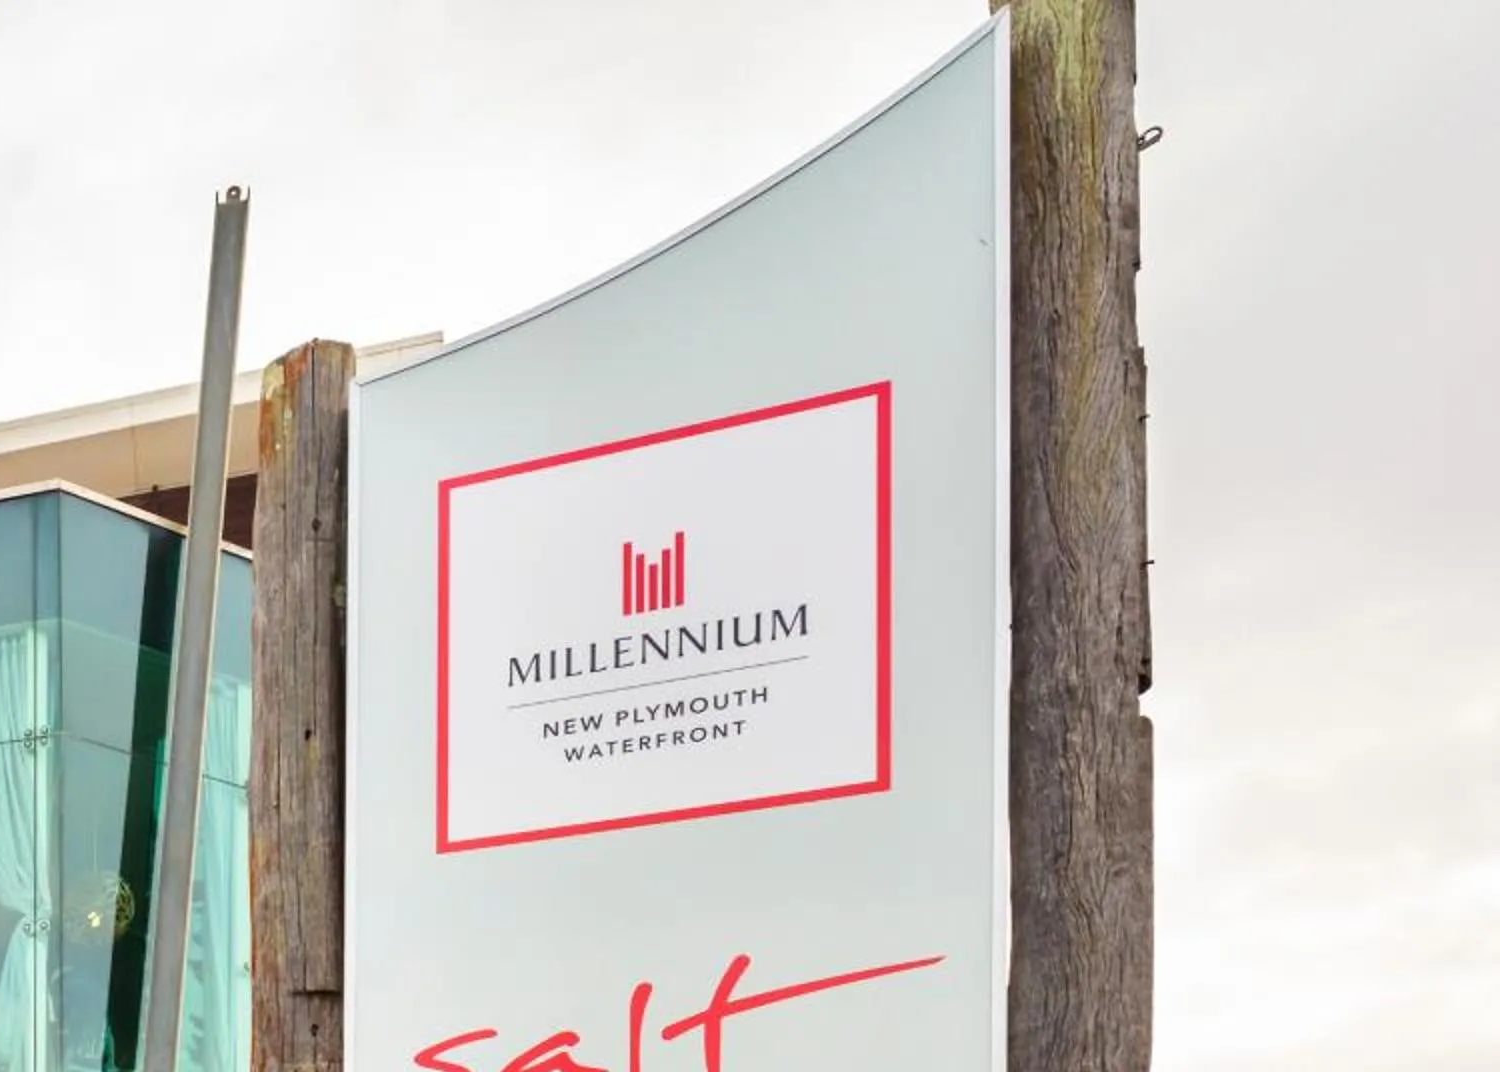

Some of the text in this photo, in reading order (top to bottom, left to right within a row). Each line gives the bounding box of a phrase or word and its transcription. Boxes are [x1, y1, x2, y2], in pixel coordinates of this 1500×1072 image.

[507, 603, 809, 688] MILLENNIUM
[542, 686, 769, 739] NEW PLYMOUTH
[563, 719, 747, 763] WATERFRONT
